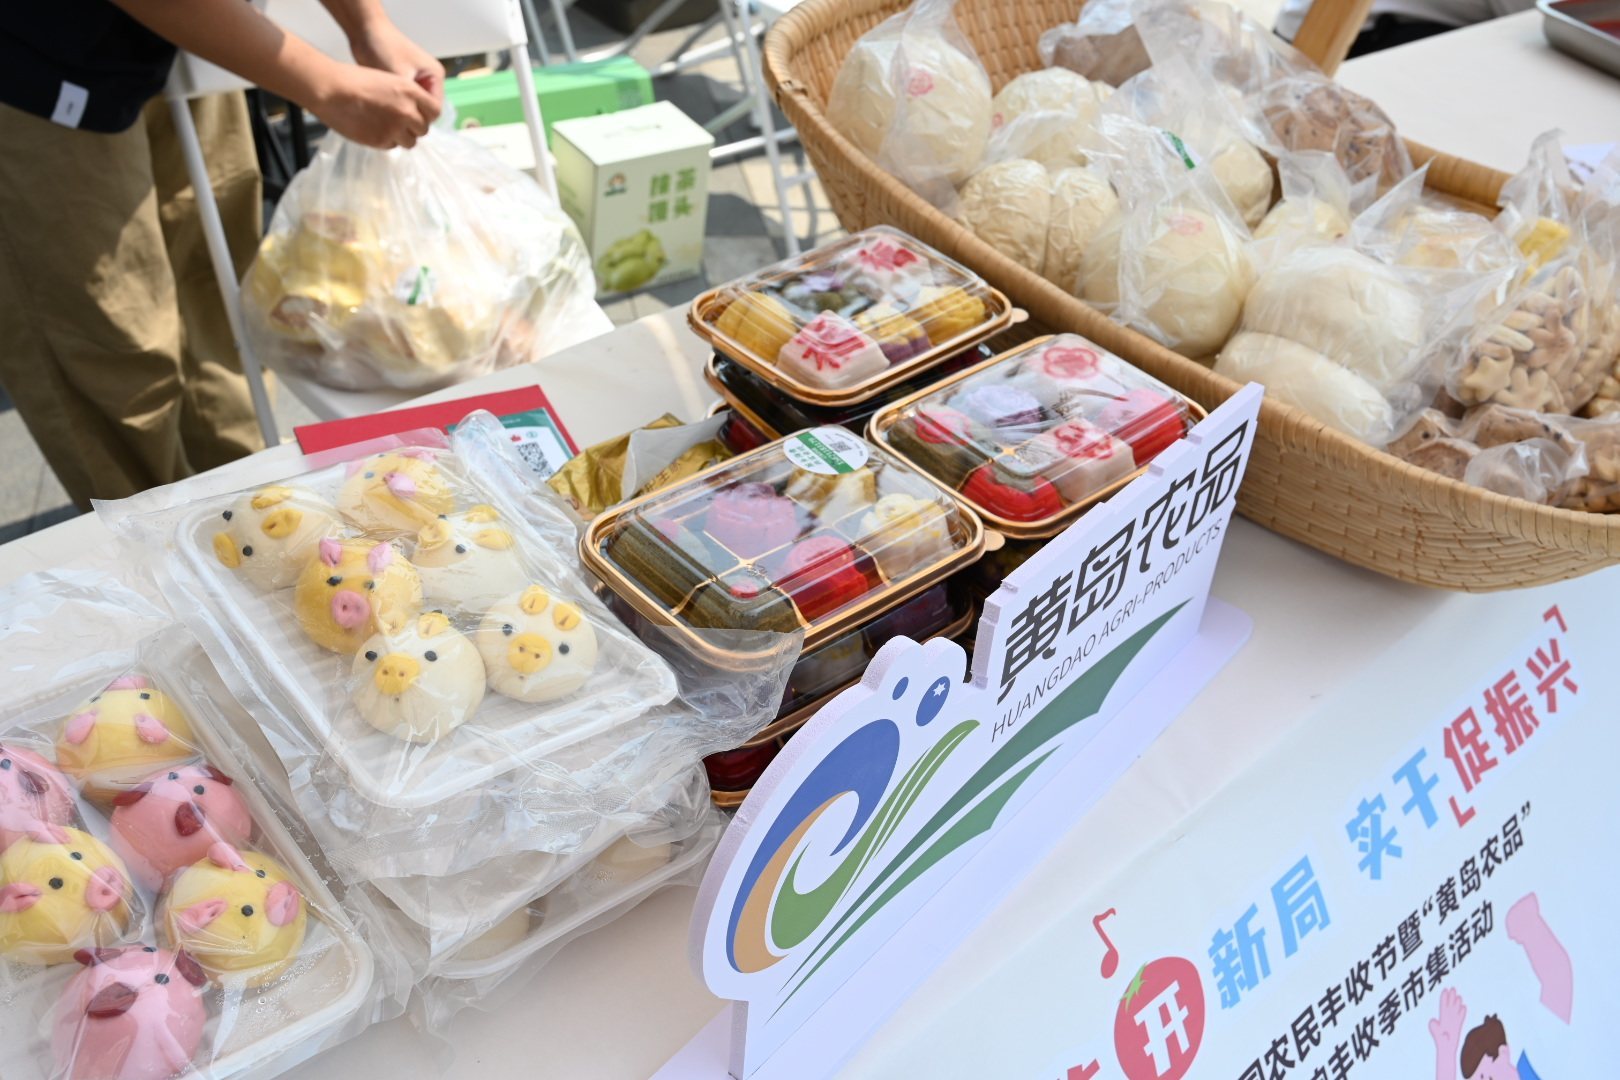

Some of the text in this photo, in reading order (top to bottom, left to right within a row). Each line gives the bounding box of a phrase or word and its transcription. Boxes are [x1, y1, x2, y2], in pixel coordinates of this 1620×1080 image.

[991, 517, 1223, 742] HUANGDAO AGRI-PRODUCTS
[996, 419, 1249, 705] 黄岛农品
